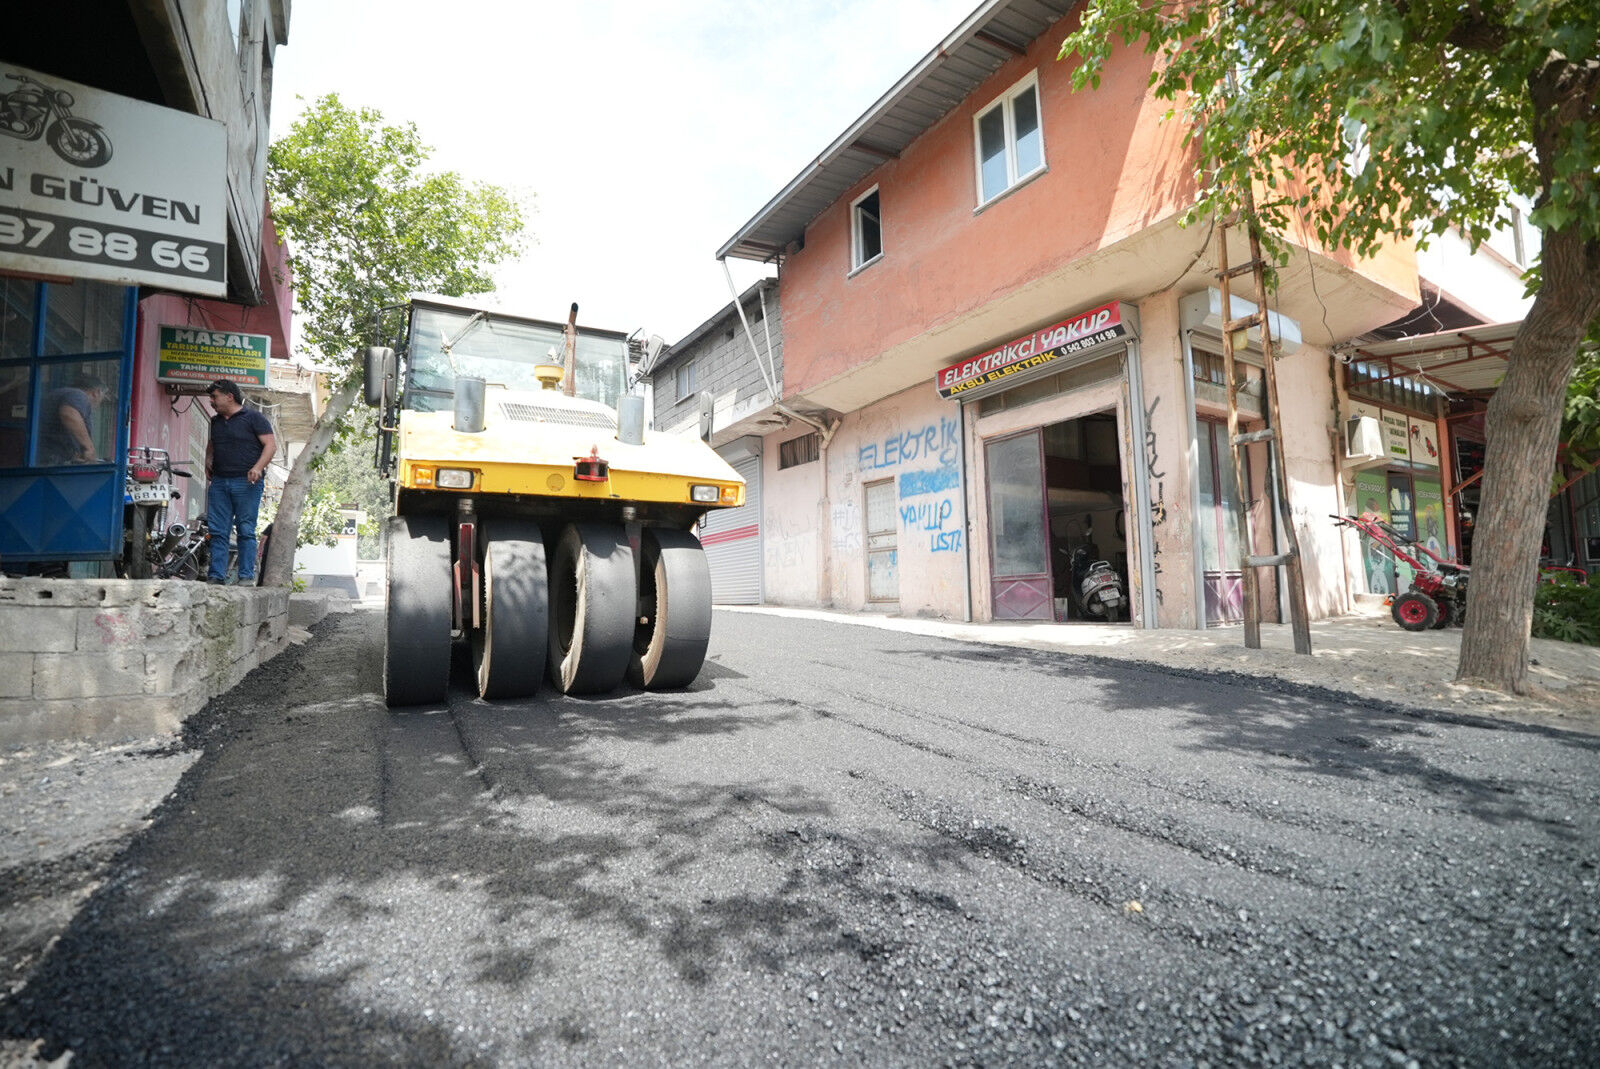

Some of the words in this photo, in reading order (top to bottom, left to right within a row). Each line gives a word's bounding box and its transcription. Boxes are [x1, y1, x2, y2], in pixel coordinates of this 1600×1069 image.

[30, 173, 200, 225] GÜVEN
[69, 226, 138, 262] 88
[151, 240, 210, 273] 66
[175, 329, 253, 350] MASAL
[1041, 309, 1111, 349] YAKUP
[987, 350, 1058, 382] ELEKTRİK
